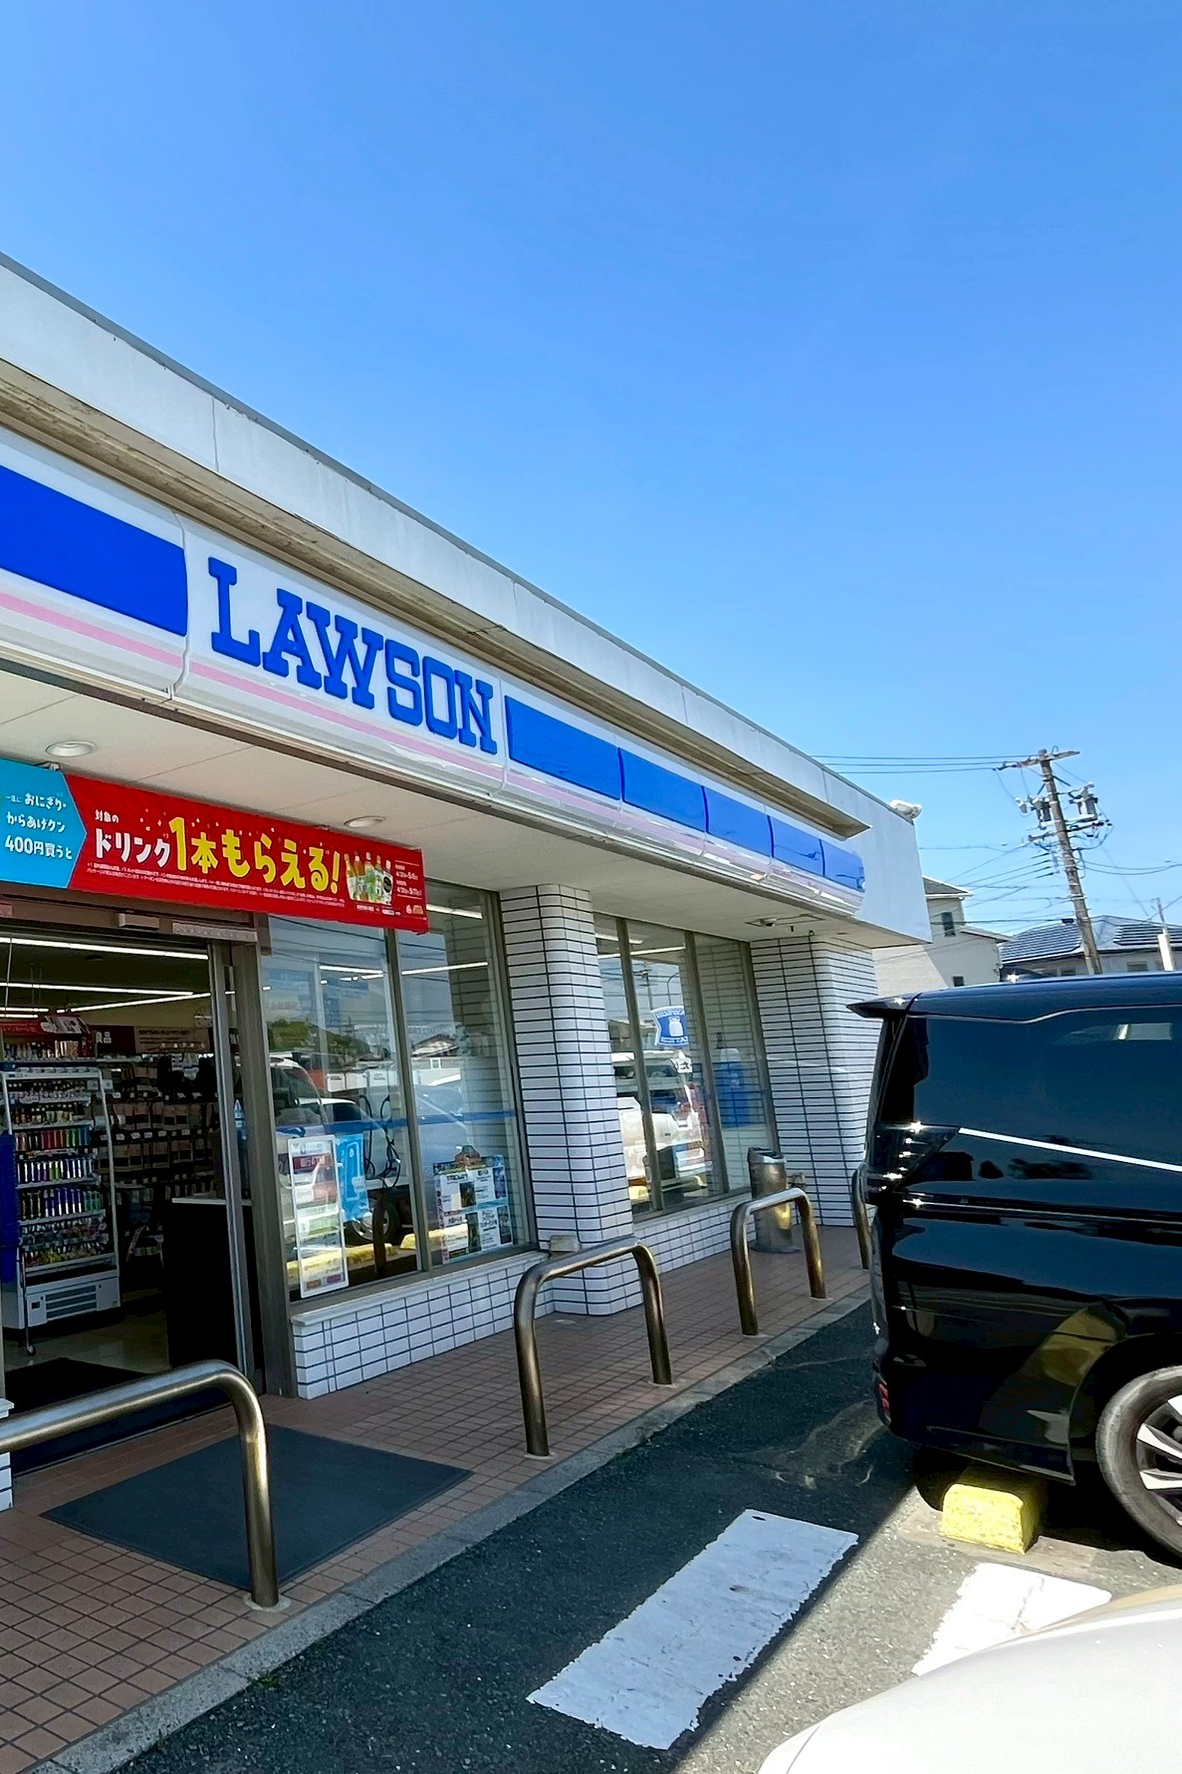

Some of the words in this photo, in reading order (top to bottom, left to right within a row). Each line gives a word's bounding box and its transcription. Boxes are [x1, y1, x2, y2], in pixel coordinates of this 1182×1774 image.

[207, 556, 498, 755] LAWSON
[6, 811, 66, 833] からあげクン
[5, 834, 73, 860] 400円買うと
[95, 827, 171, 868] ドリンク
